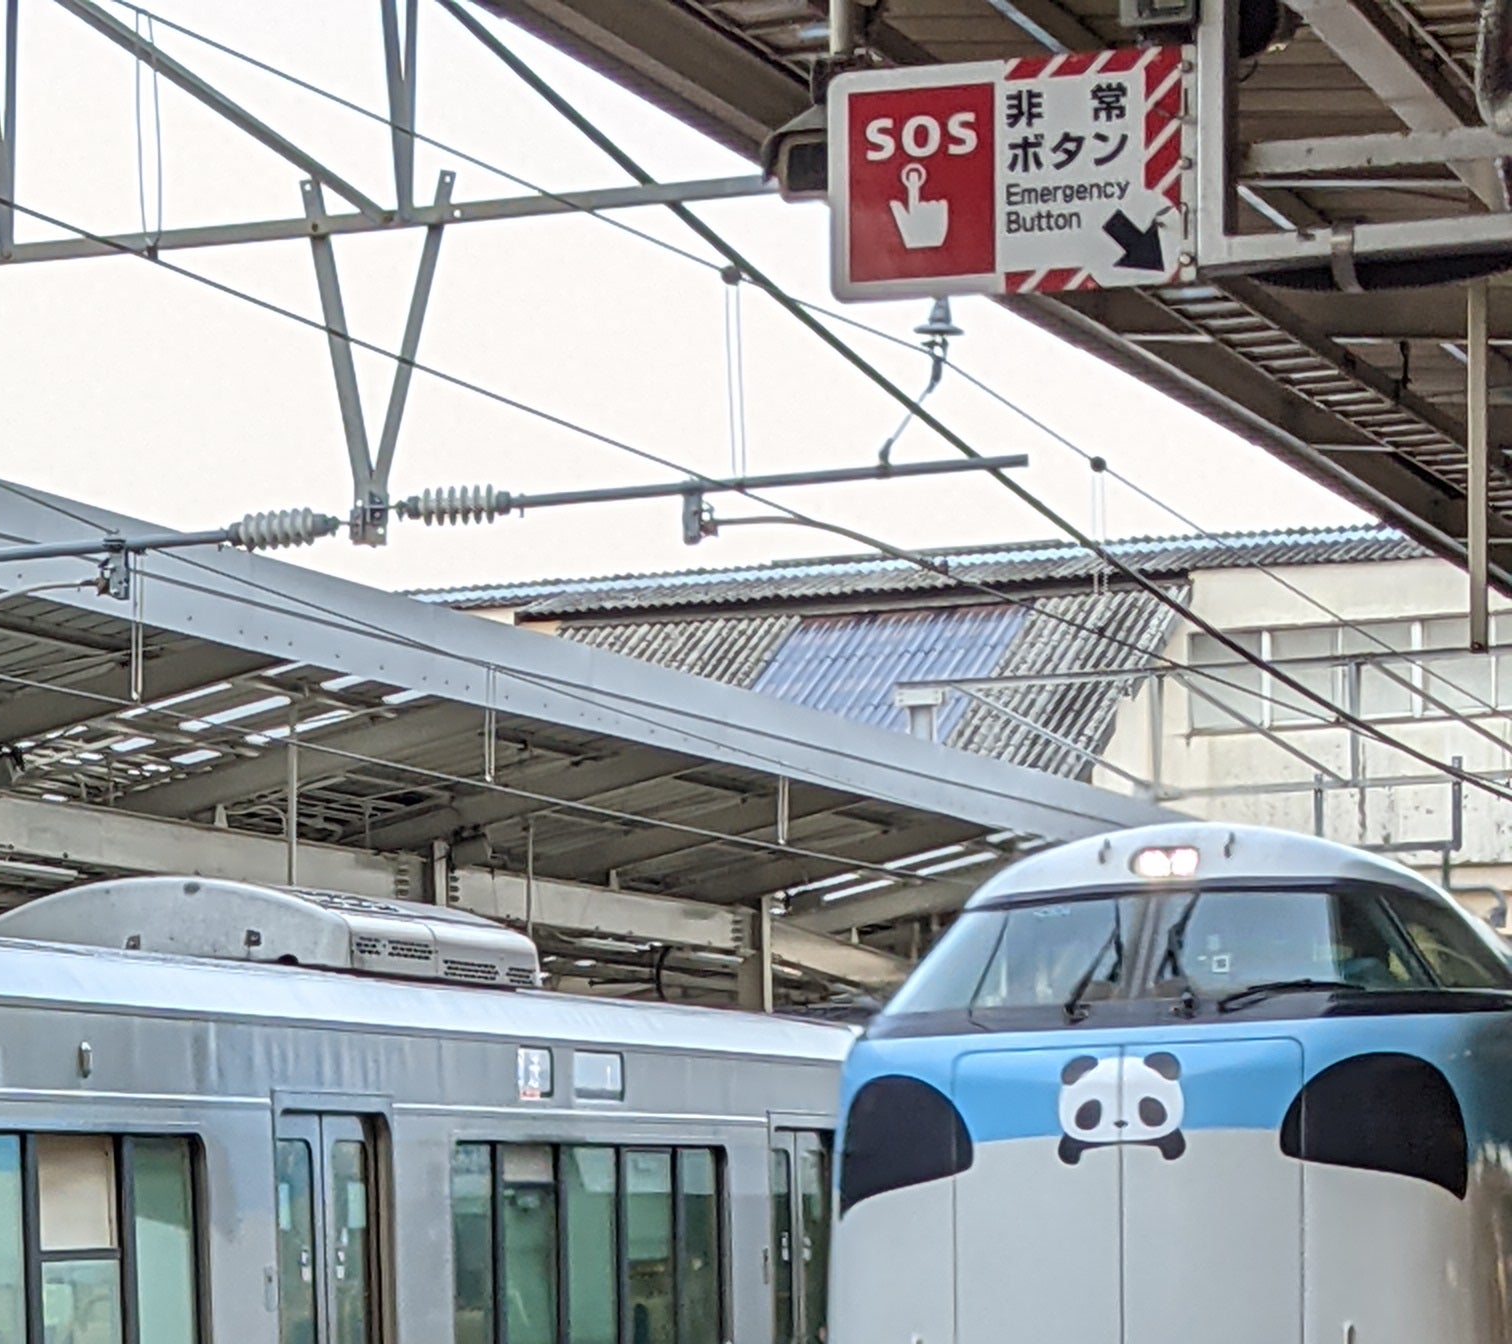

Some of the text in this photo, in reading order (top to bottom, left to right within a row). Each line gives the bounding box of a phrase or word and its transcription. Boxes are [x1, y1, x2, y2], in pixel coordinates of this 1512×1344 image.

[1006, 82, 1128, 128] 非常
[865, 111, 978, 162] SOS
[1006, 130, 1129, 173] ボタン
[1006, 180, 1130, 206] Emergency
[1006, 209, 1081, 234] Button
